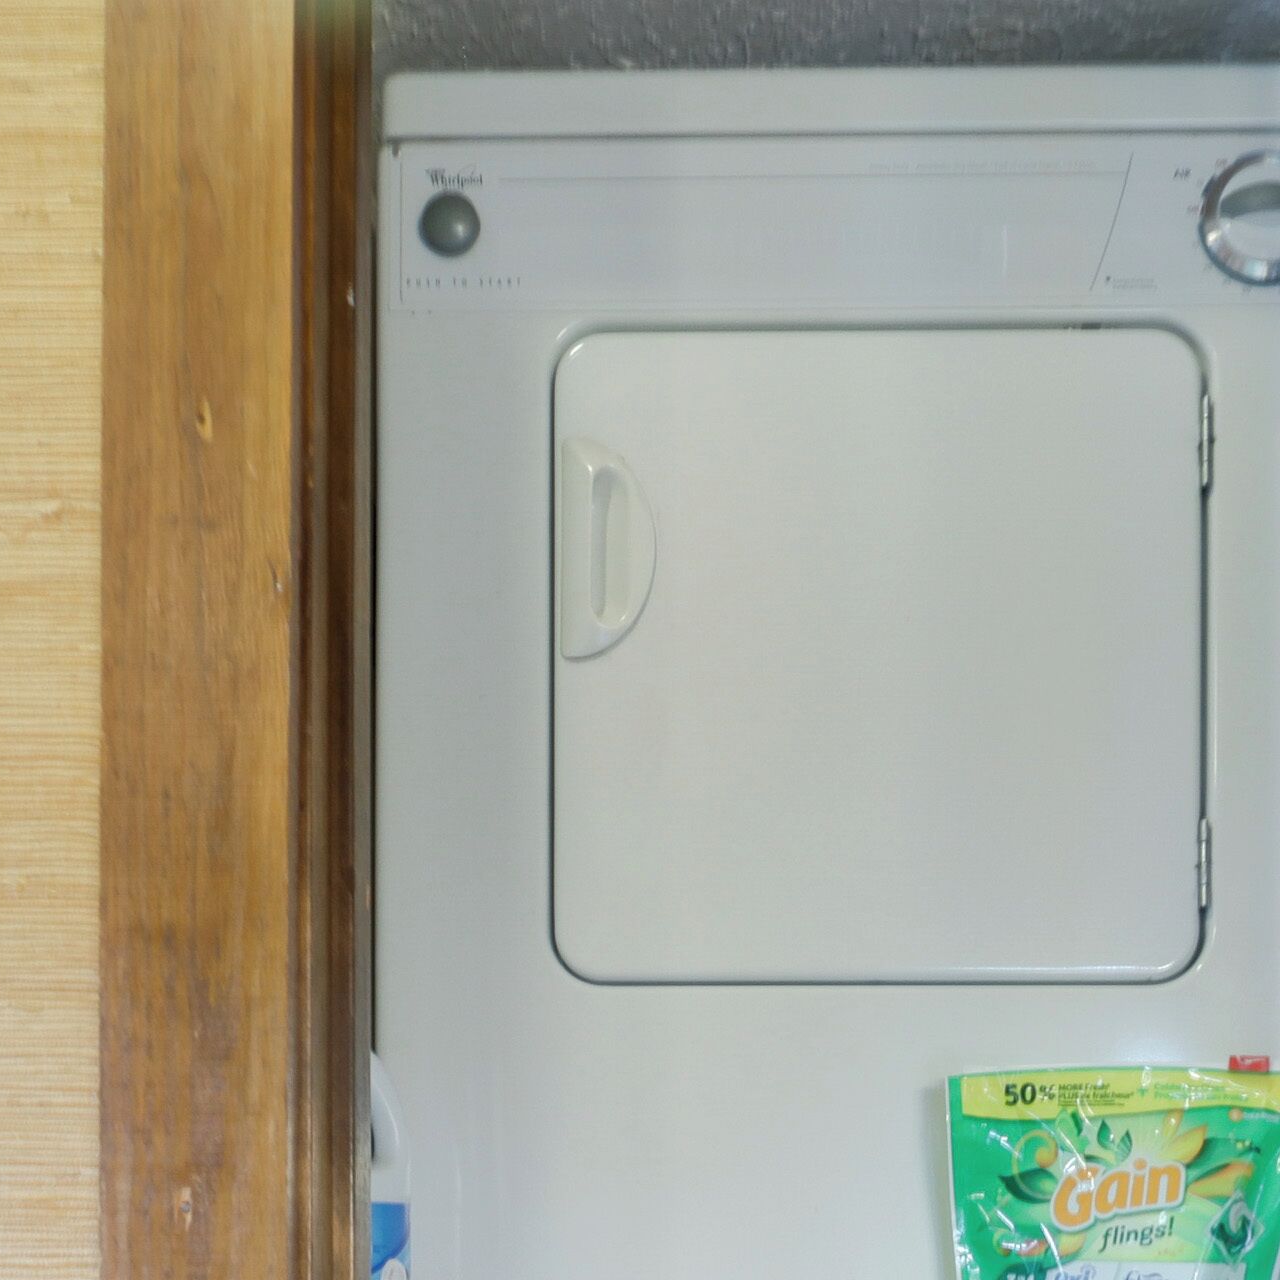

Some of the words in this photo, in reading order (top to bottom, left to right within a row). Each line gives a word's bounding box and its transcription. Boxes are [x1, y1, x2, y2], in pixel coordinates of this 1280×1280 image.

[426, 170, 484, 189] Whirlpool
[1052, 1156, 1184, 1229] Gain
[1098, 1216, 1175, 1253] flings!
